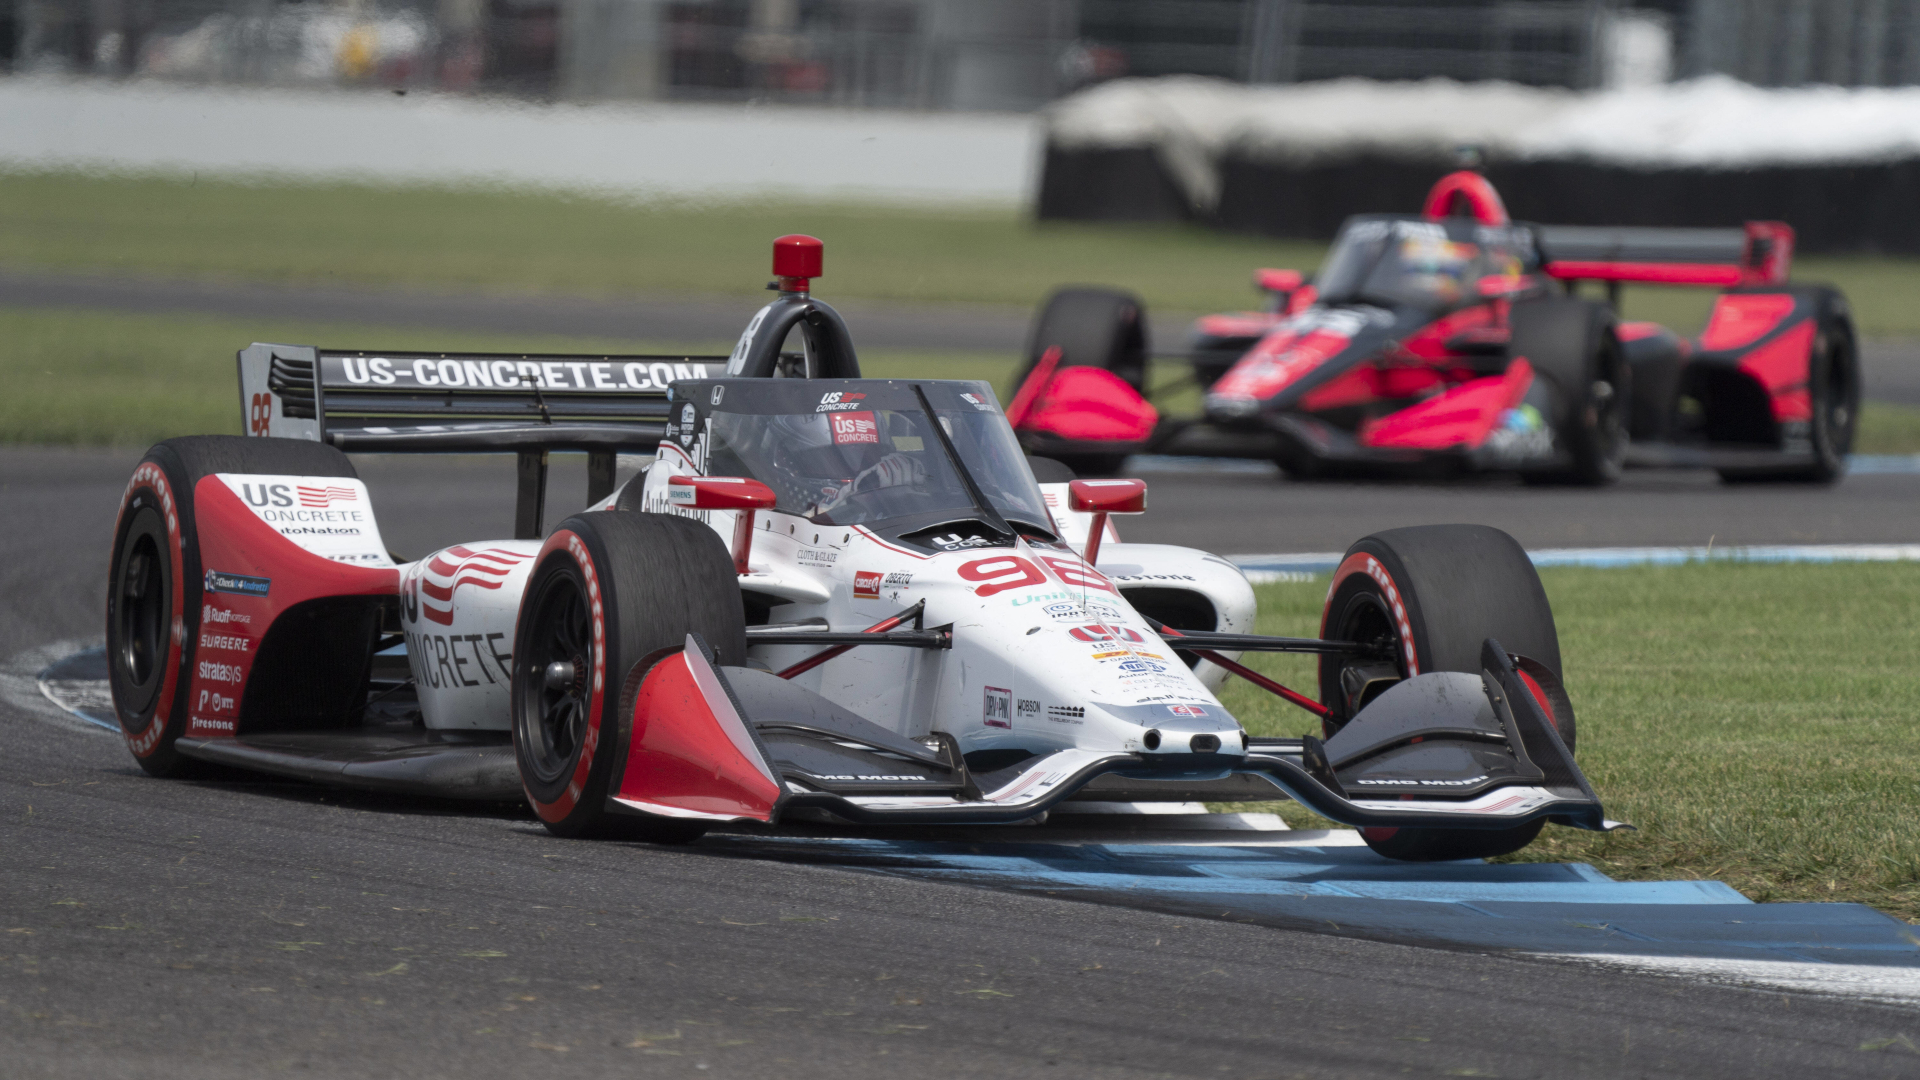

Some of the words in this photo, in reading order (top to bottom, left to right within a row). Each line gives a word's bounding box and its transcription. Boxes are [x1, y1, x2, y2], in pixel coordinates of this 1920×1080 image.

[341, 357, 709, 388] US-CONCRETE.COM
[820, 391, 843, 405] US
[815, 402, 861, 413] CONCRETE
[834, 419, 856, 434] US
[837, 433, 878, 443] CONCRETE
[242, 483, 294, 507] US
[669, 490, 692, 499] SIEMENS
[258, 509, 364, 522] ONCRETE
[279, 526, 360, 535] toNation
[855, 578, 872, 589] CIRCLE
[885, 572, 913, 585] OBERTO
[957, 555, 1123, 598] 98
[211, 608, 231, 623] Ruoff
[1366, 557, 1418, 678] Firesto
[200, 634, 250, 651] SURGERE
[1092, 641, 1116, 649] US
[405, 630, 513, 690] ONCRETE
[1110, 656, 1172, 666] GAINRIDGE
[199, 660, 242, 686] stratasys
[1017, 698, 1041, 717] HOBSON
[192, 716, 234, 731] Firestone
